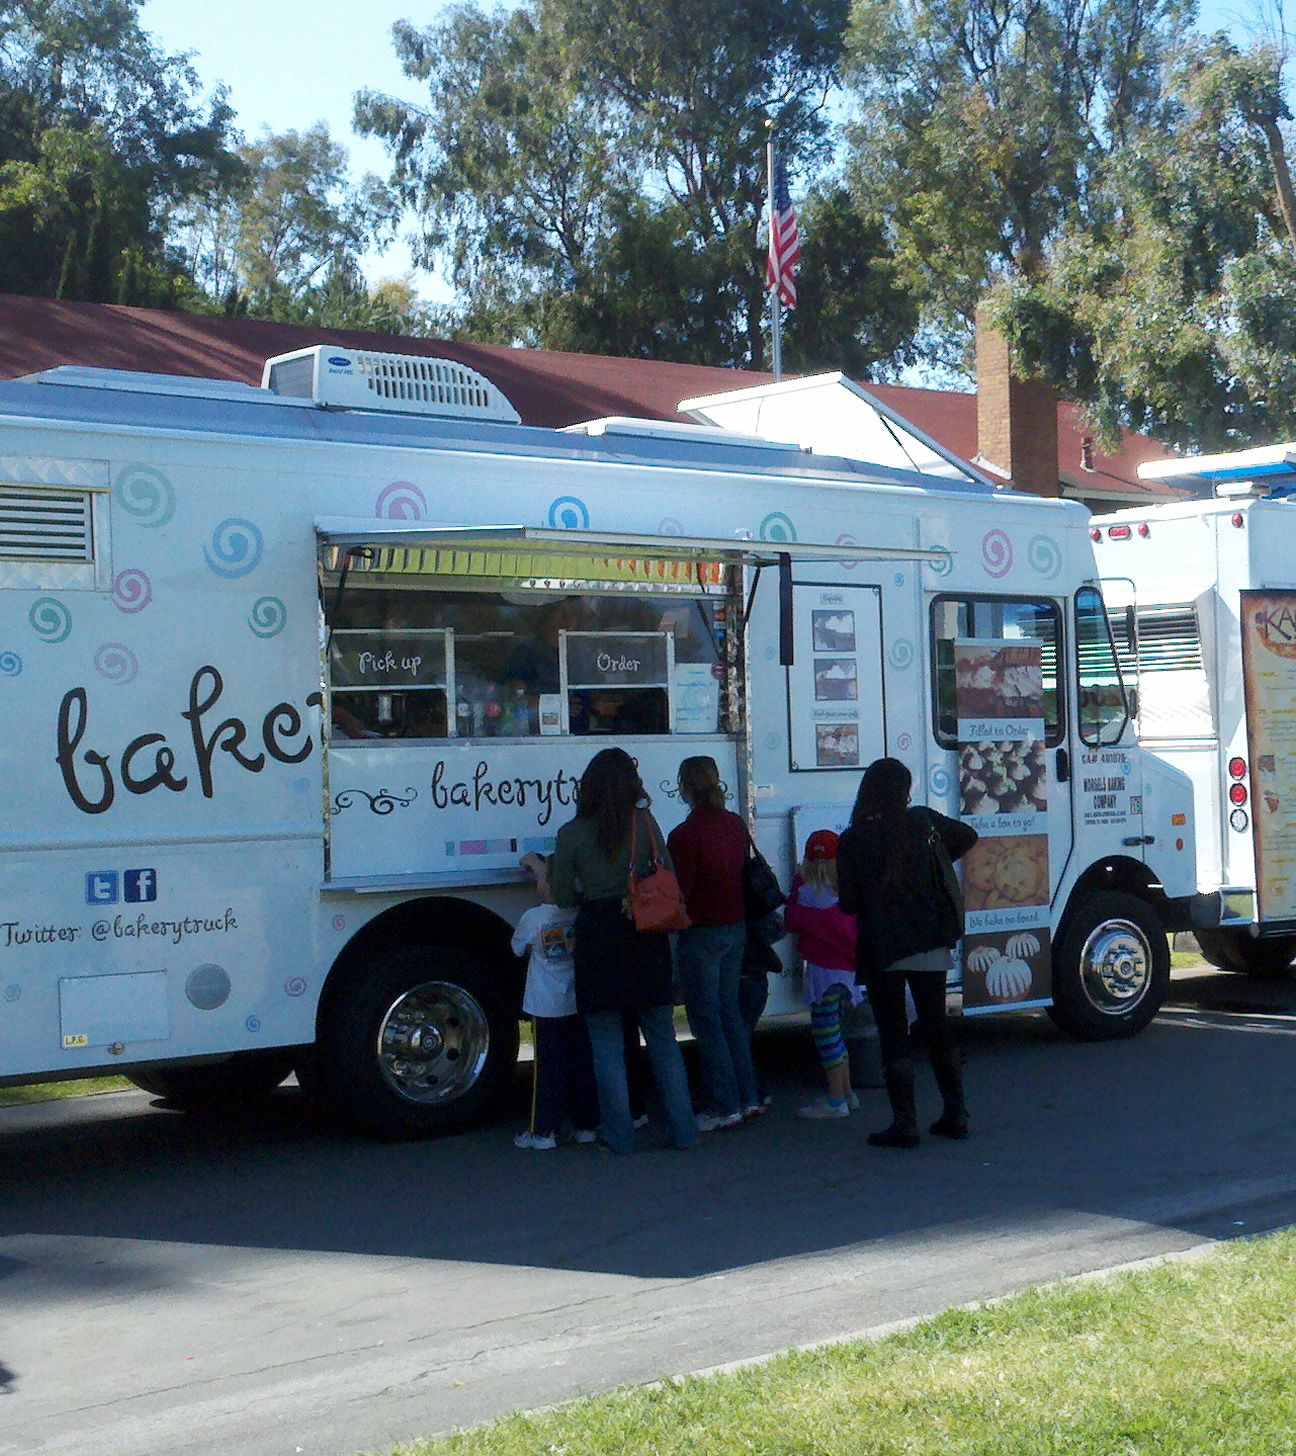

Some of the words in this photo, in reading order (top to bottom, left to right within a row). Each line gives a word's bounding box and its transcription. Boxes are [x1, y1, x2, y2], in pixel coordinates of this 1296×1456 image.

[359, 651, 396, 674] Pick
[402, 654, 422, 676] up
[596, 652, 641, 672] Order
[56, 665, 323, 814] bake
[92, 907, 238, 945] @bakerytruck
